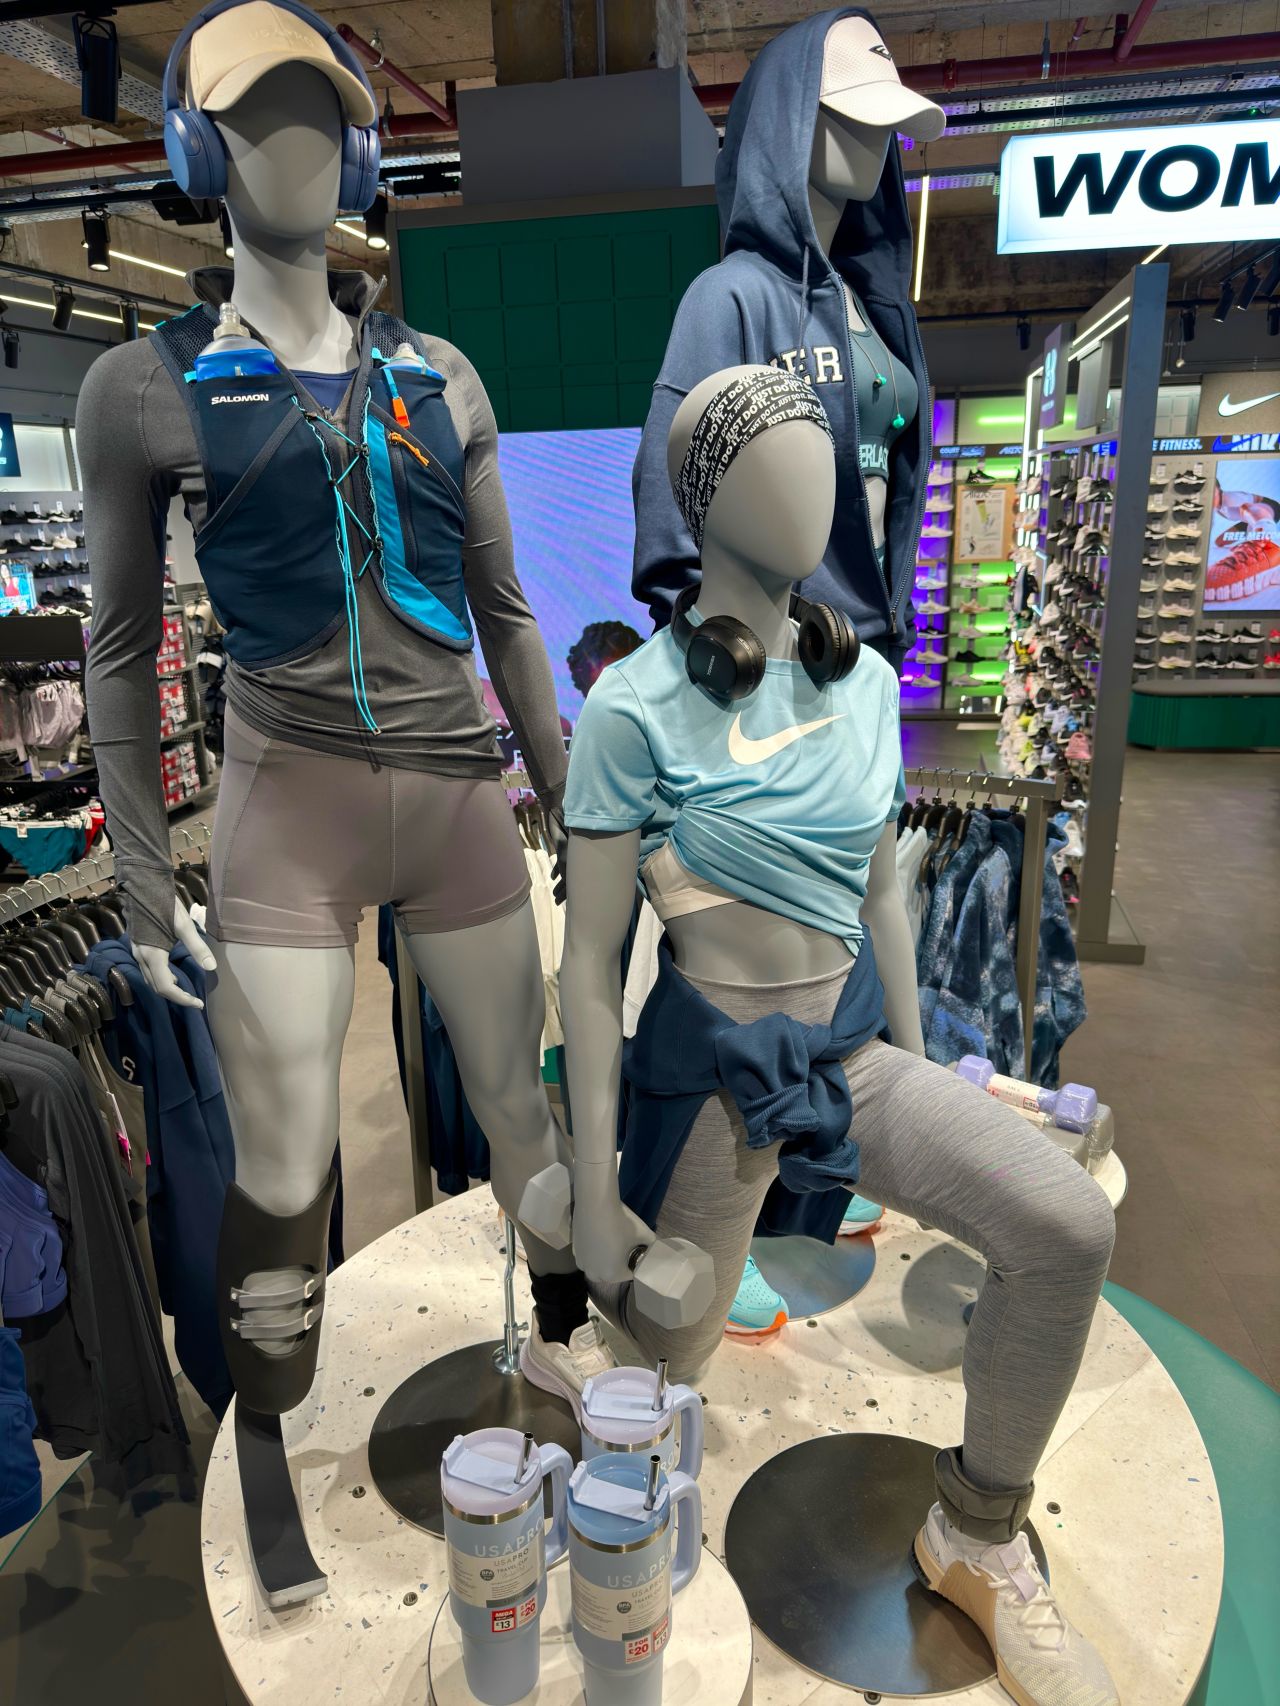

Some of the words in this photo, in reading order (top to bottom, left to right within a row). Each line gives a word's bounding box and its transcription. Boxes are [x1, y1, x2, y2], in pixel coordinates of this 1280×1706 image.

[211, 393, 270, 406] SALOMON
[709, 397, 729, 424] JUST
[727, 384, 744, 400] DO
[750, 387, 773, 405] JUST
[773, 384, 790, 394] DO
[725, 416, 744, 445] JUST
[742, 404, 759, 421] DO
[757, 398, 771, 409] IT.
[765, 410, 786, 428] JUST
[786, 408, 802, 418] DO
[706, 423, 719, 444] DO
[1230, 433, 1280, 452] NIK
[721, 445, 733, 464] DO
[474, 1515, 544, 1558] USAPRO
[494, 1548, 529, 1567] USAPRO
[496, 1620, 511, 1629] £13
[628, 1643, 649, 1656] £20
[634, 1637, 649, 1647] FOR
